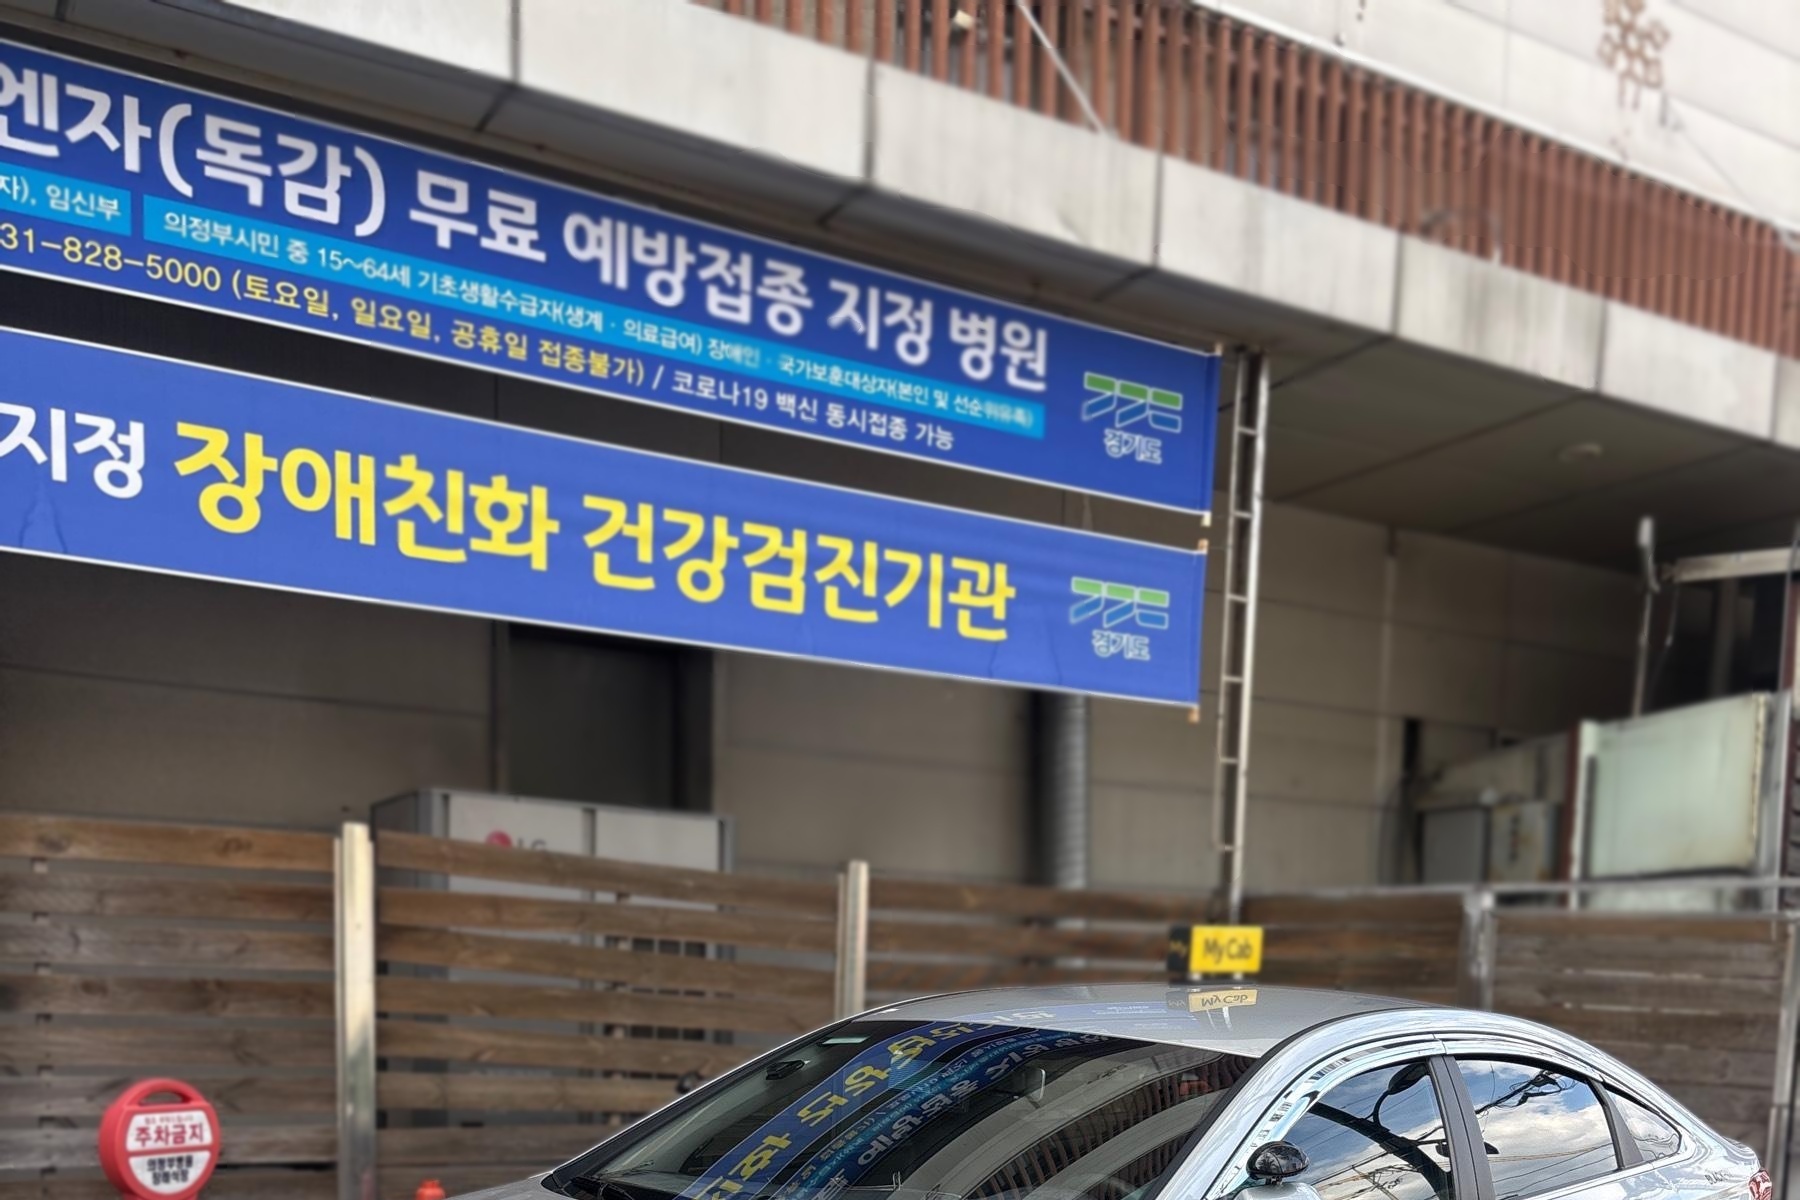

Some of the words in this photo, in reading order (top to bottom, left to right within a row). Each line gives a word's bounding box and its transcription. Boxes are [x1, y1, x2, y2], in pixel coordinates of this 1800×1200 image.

[46, 183, 121, 221] 임신부
[163, 211, 279, 258] 의정부시민
[287, 238, 310, 265] 중
[317, 247, 411, 289] 15~64세
[417, 270, 603, 333] 기초생활수급자(생계
[623, 318, 702, 356] 의료급여)
[410, 169, 547, 263] 무료
[563, 211, 813, 336] 예방접종
[827, 278, 935, 366] 지정
[948, 307, 1047, 391] 병원
[231, 269, 339, 321] (토요일,
[351, 297, 440, 343] 일요일,
[451, 319, 528, 361] 공휴일
[538, 339, 645, 387] 접종불가)
[671, 370, 769, 410] 코로나19
[775, 391, 818, 424] 백신
[825, 402, 908, 442] 동시접종
[914, 421, 955, 451] 가능
[1104, 430, 1162, 464] 경기도
[0, 403, 146, 499] 지정
[173, 421, 559, 571] 장애친화
[582, 493, 1016, 642] 건강검진기관
[1092, 631, 1151, 661] 경기도
[135, 1122, 204, 1147] 주차금지
